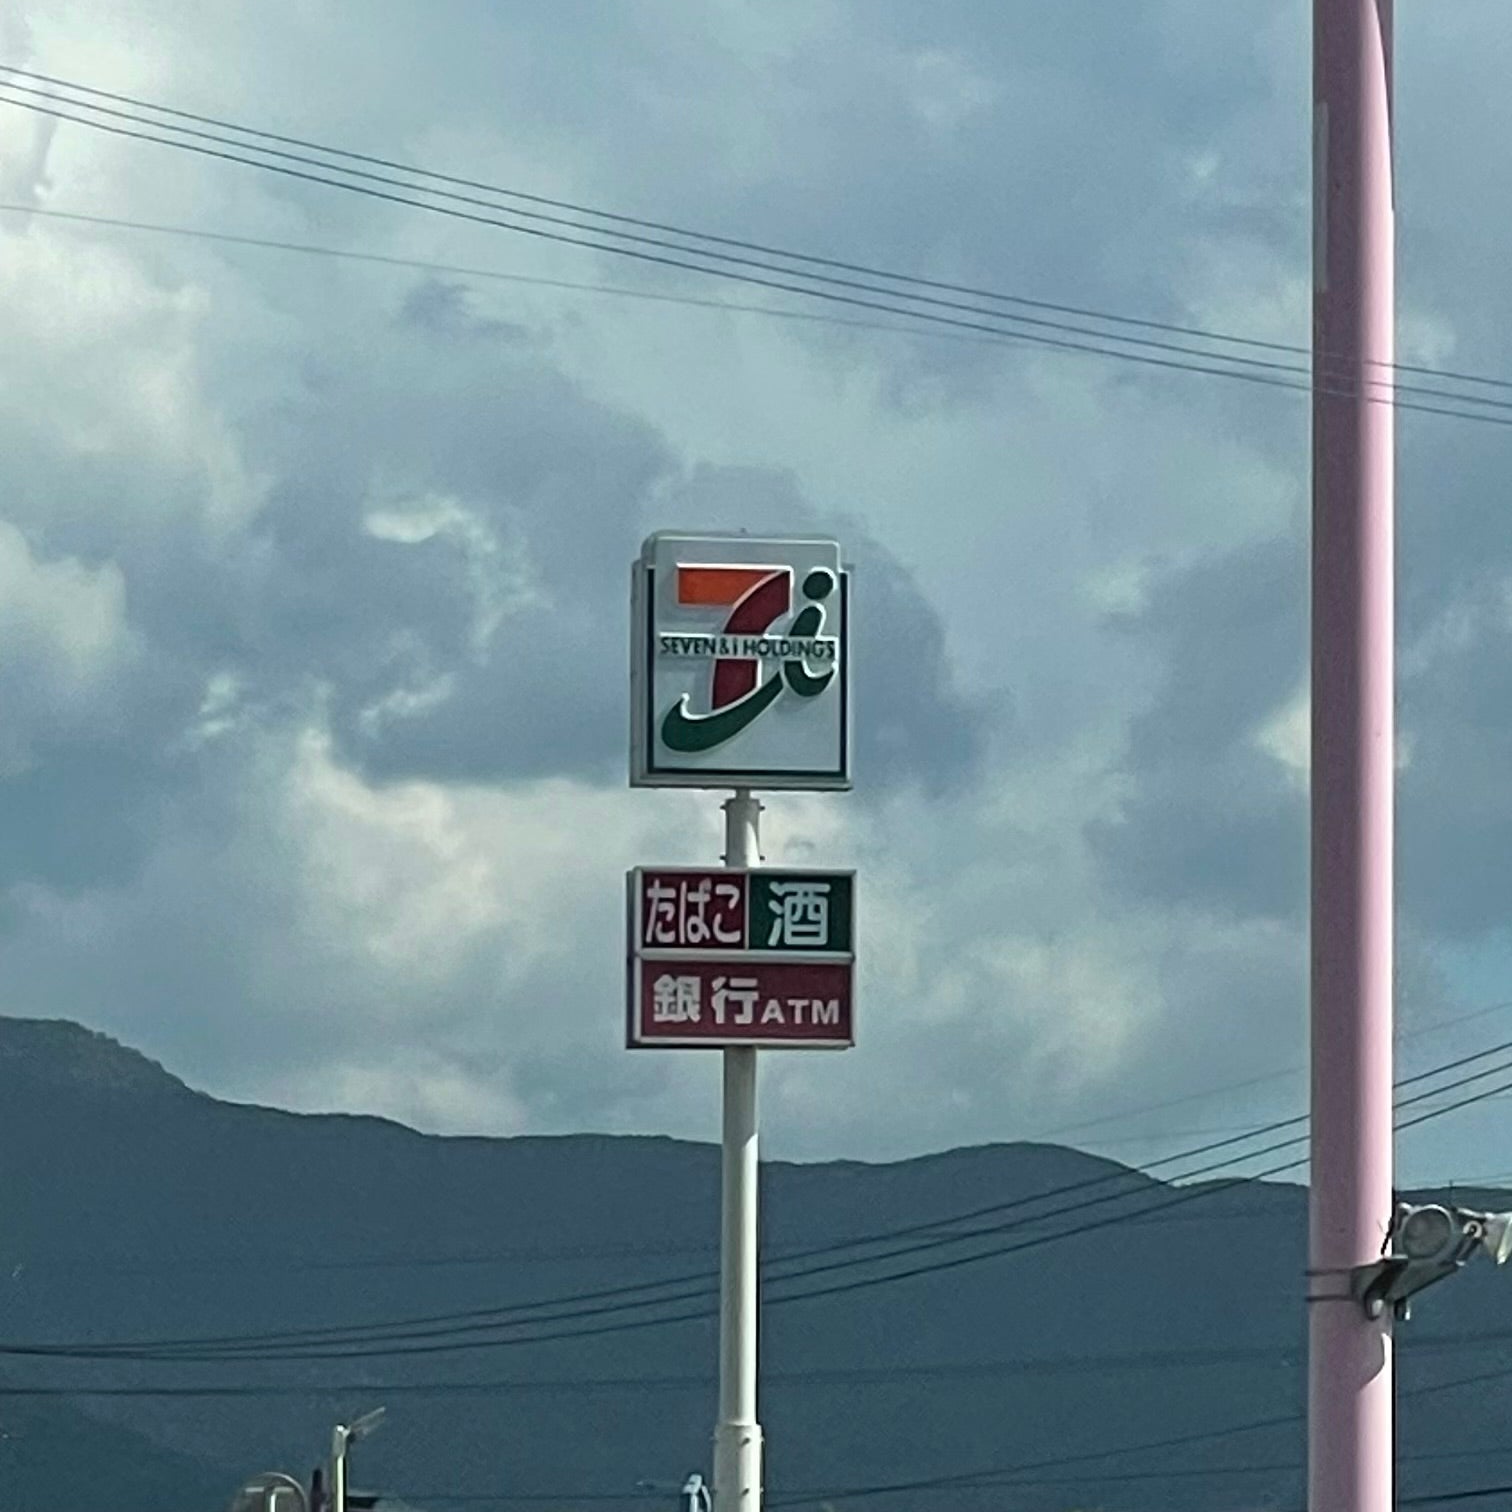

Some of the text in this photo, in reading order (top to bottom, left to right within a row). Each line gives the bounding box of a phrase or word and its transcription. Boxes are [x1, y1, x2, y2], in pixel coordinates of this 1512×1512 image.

[743, 639, 835, 657] HOLDINGS
[645, 878, 831, 946] たばこ 酒
